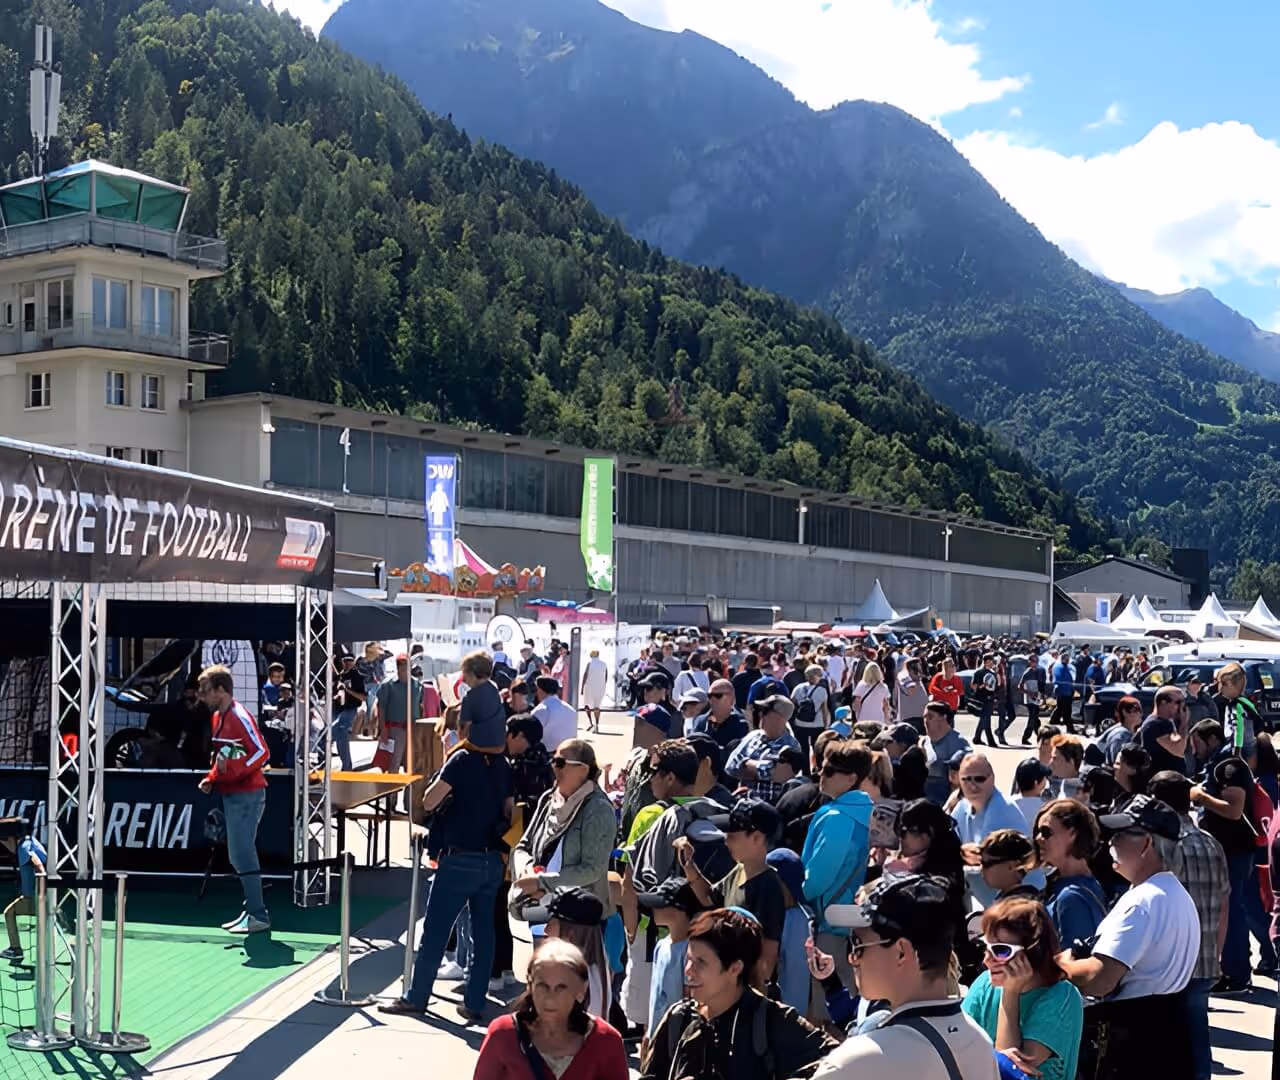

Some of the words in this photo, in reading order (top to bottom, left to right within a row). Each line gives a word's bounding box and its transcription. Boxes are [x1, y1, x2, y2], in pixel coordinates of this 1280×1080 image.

[104, 494, 140, 556] DE
[140, 500, 252, 563] FOOTBALL
[84, 801, 193, 850] RENA
